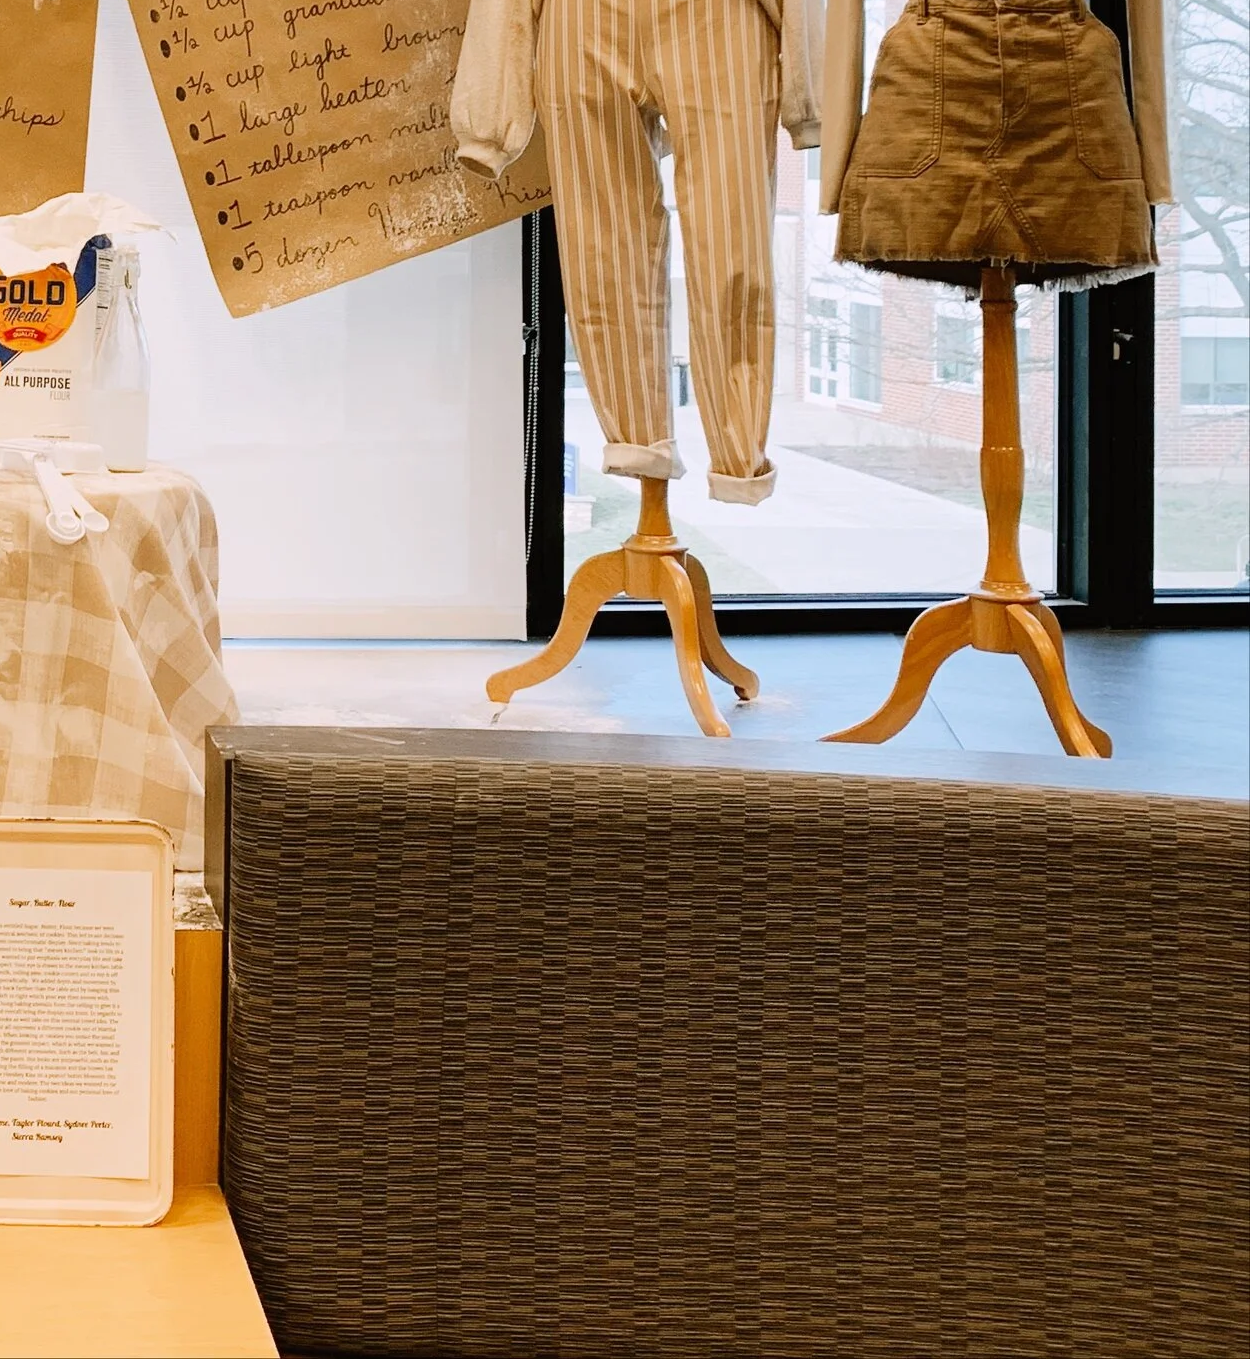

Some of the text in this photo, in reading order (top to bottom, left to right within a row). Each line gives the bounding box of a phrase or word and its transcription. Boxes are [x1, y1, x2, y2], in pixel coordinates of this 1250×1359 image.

[214, 19, 255, 57] cup
[225, 64, 265, 93] cup
[287, 39, 351, 82] light
[202, 110, 226, 144] 1
[238, 99, 307, 136] large
[216, 159, 242, 187] 1
[248, 131, 373, 177] tablespoon
[230, 199, 252, 230] 1
[261, 179, 375, 221] teaspoon
[244, 241, 264, 274] 5
[276, 232, 359, 270] dozen
[2, 307, 52, 324] Medal
[4, 376, 71, 390] ALL PURPOSE
